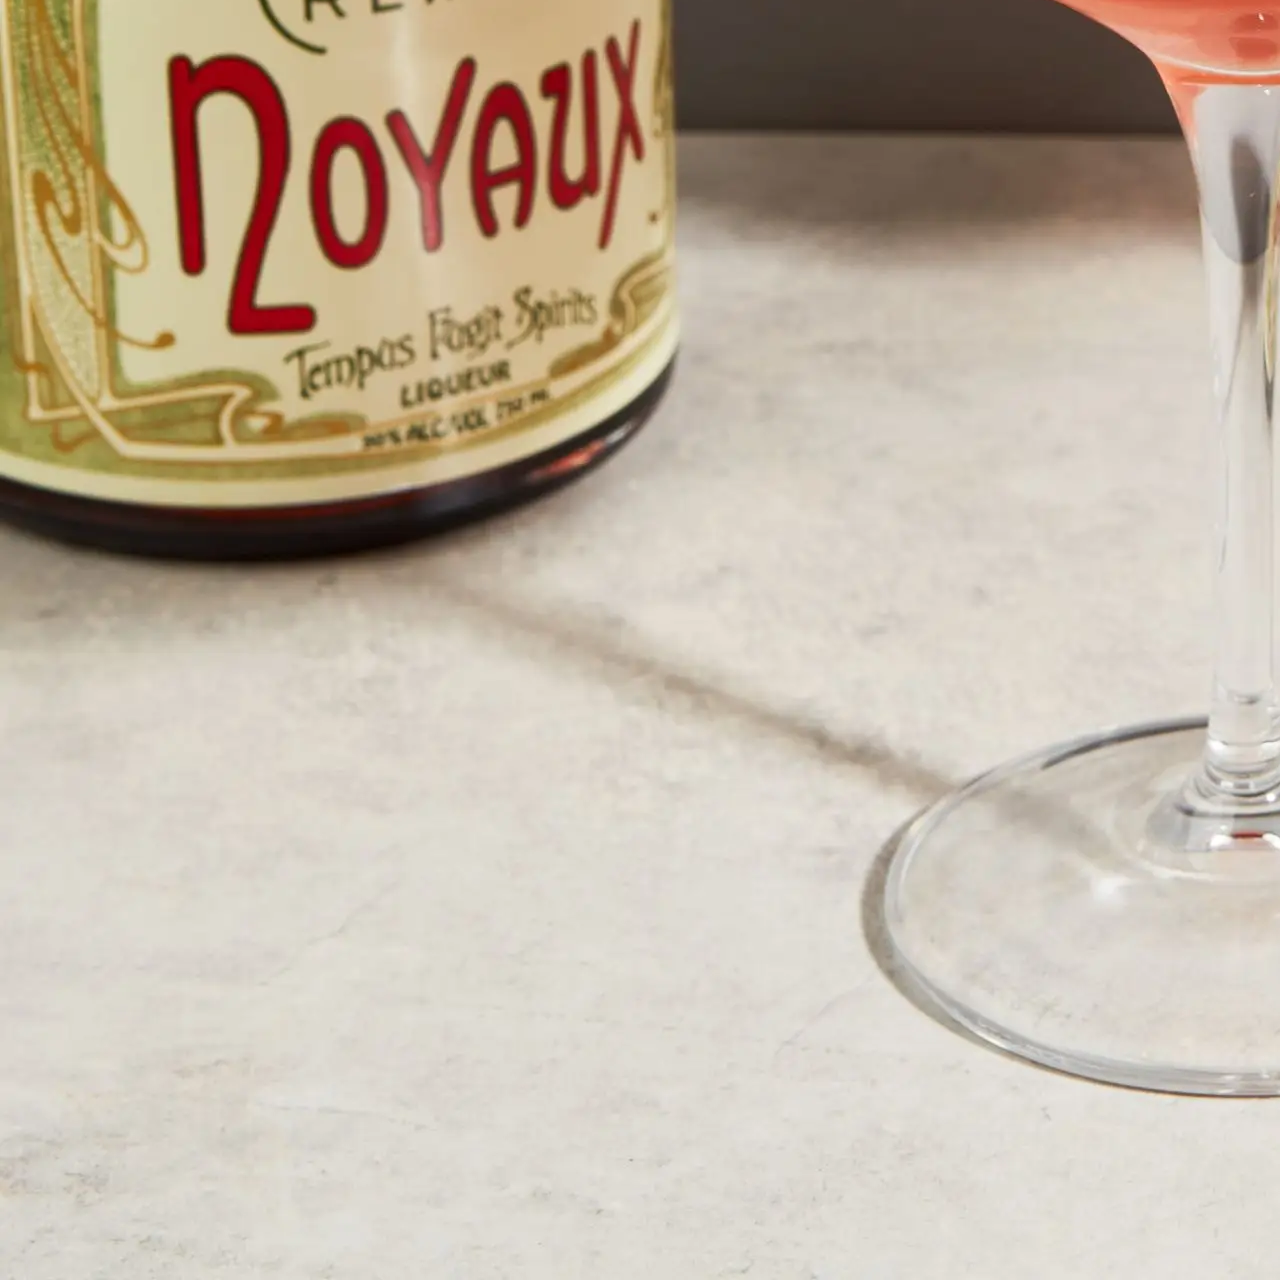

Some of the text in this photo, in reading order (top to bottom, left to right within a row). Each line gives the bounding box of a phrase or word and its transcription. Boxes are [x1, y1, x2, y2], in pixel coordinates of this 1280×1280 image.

[167, 18, 646, 336] NOYAUX
[505, 285, 598, 350] Spirits
[401, 359, 511, 409] LIQUEUR
